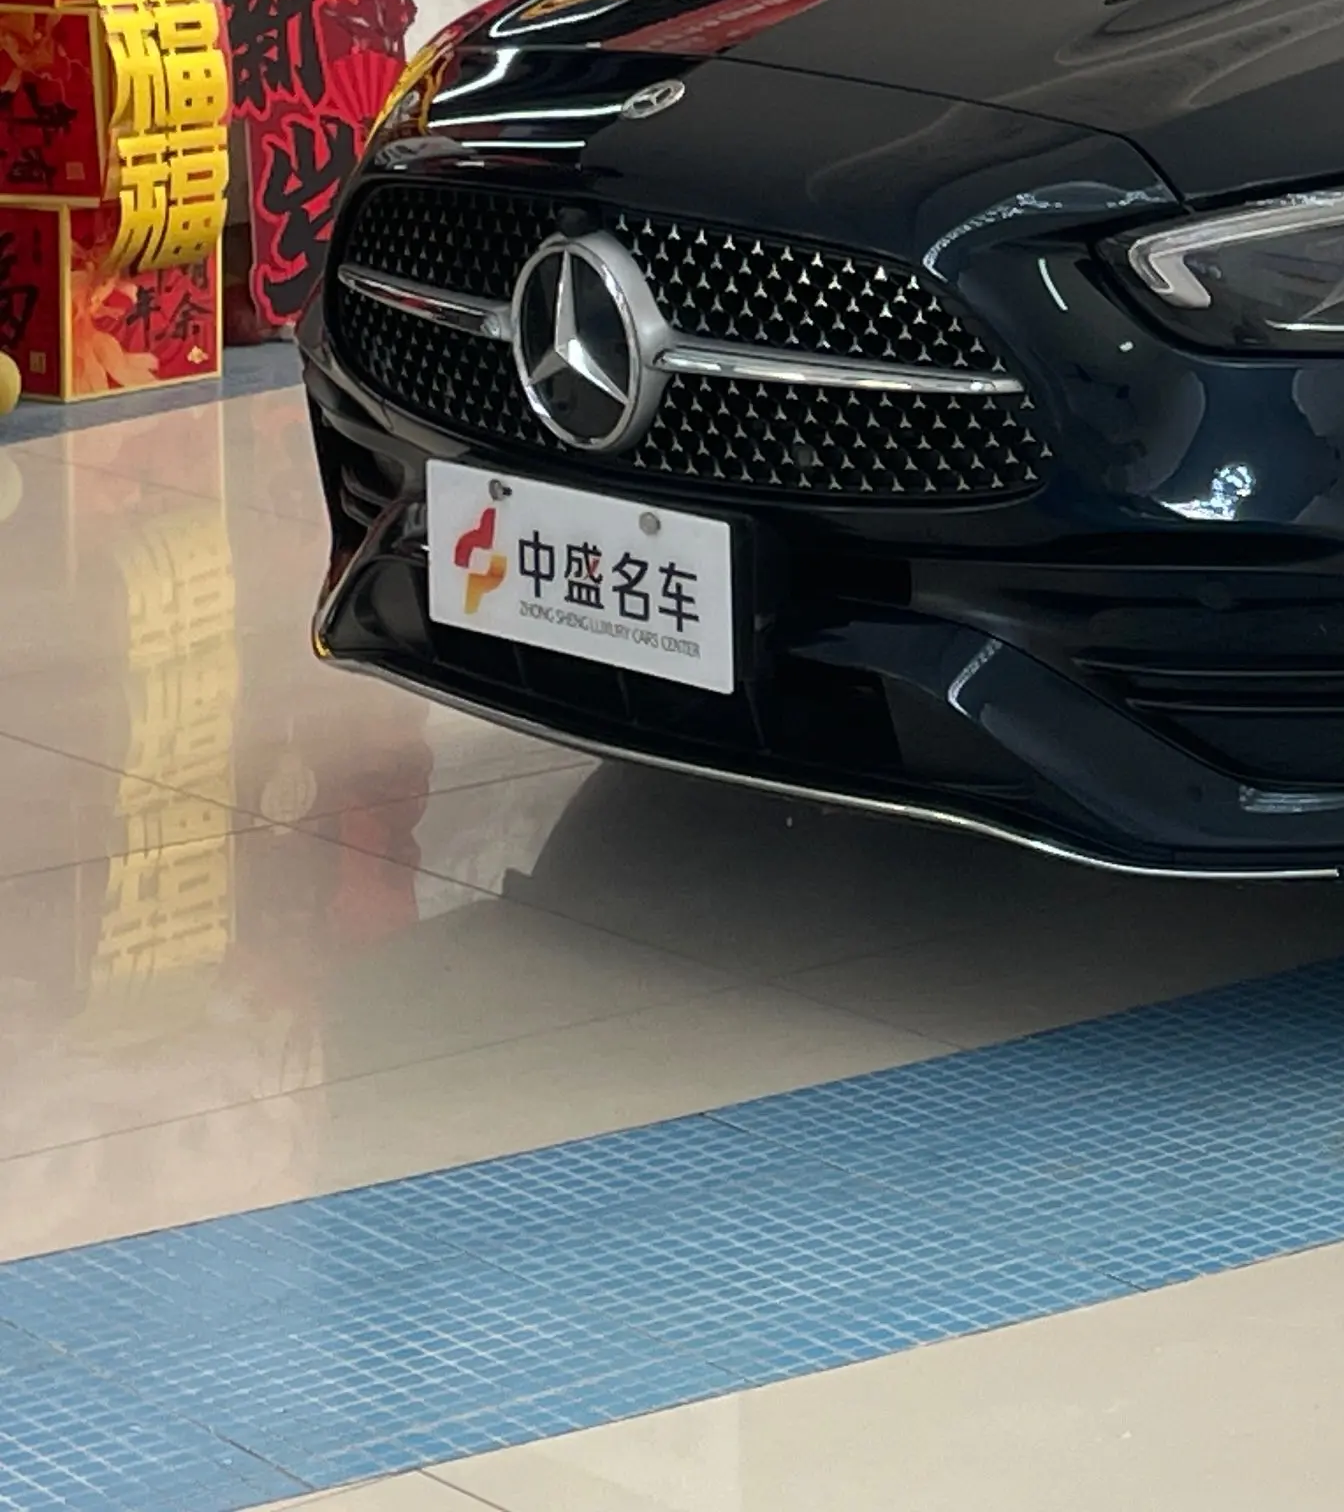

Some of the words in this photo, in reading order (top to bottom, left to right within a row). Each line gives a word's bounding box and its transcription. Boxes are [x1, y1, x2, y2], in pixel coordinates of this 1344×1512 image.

[518, 529, 700, 633] 中盛名车
[519, 600, 554, 624] ZHONG
[555, 609, 589, 632] SHENG
[590, 618, 631, 641] LUXURY
[632, 627, 660, 649] CARS
[661, 636, 701, 658] CENTER
